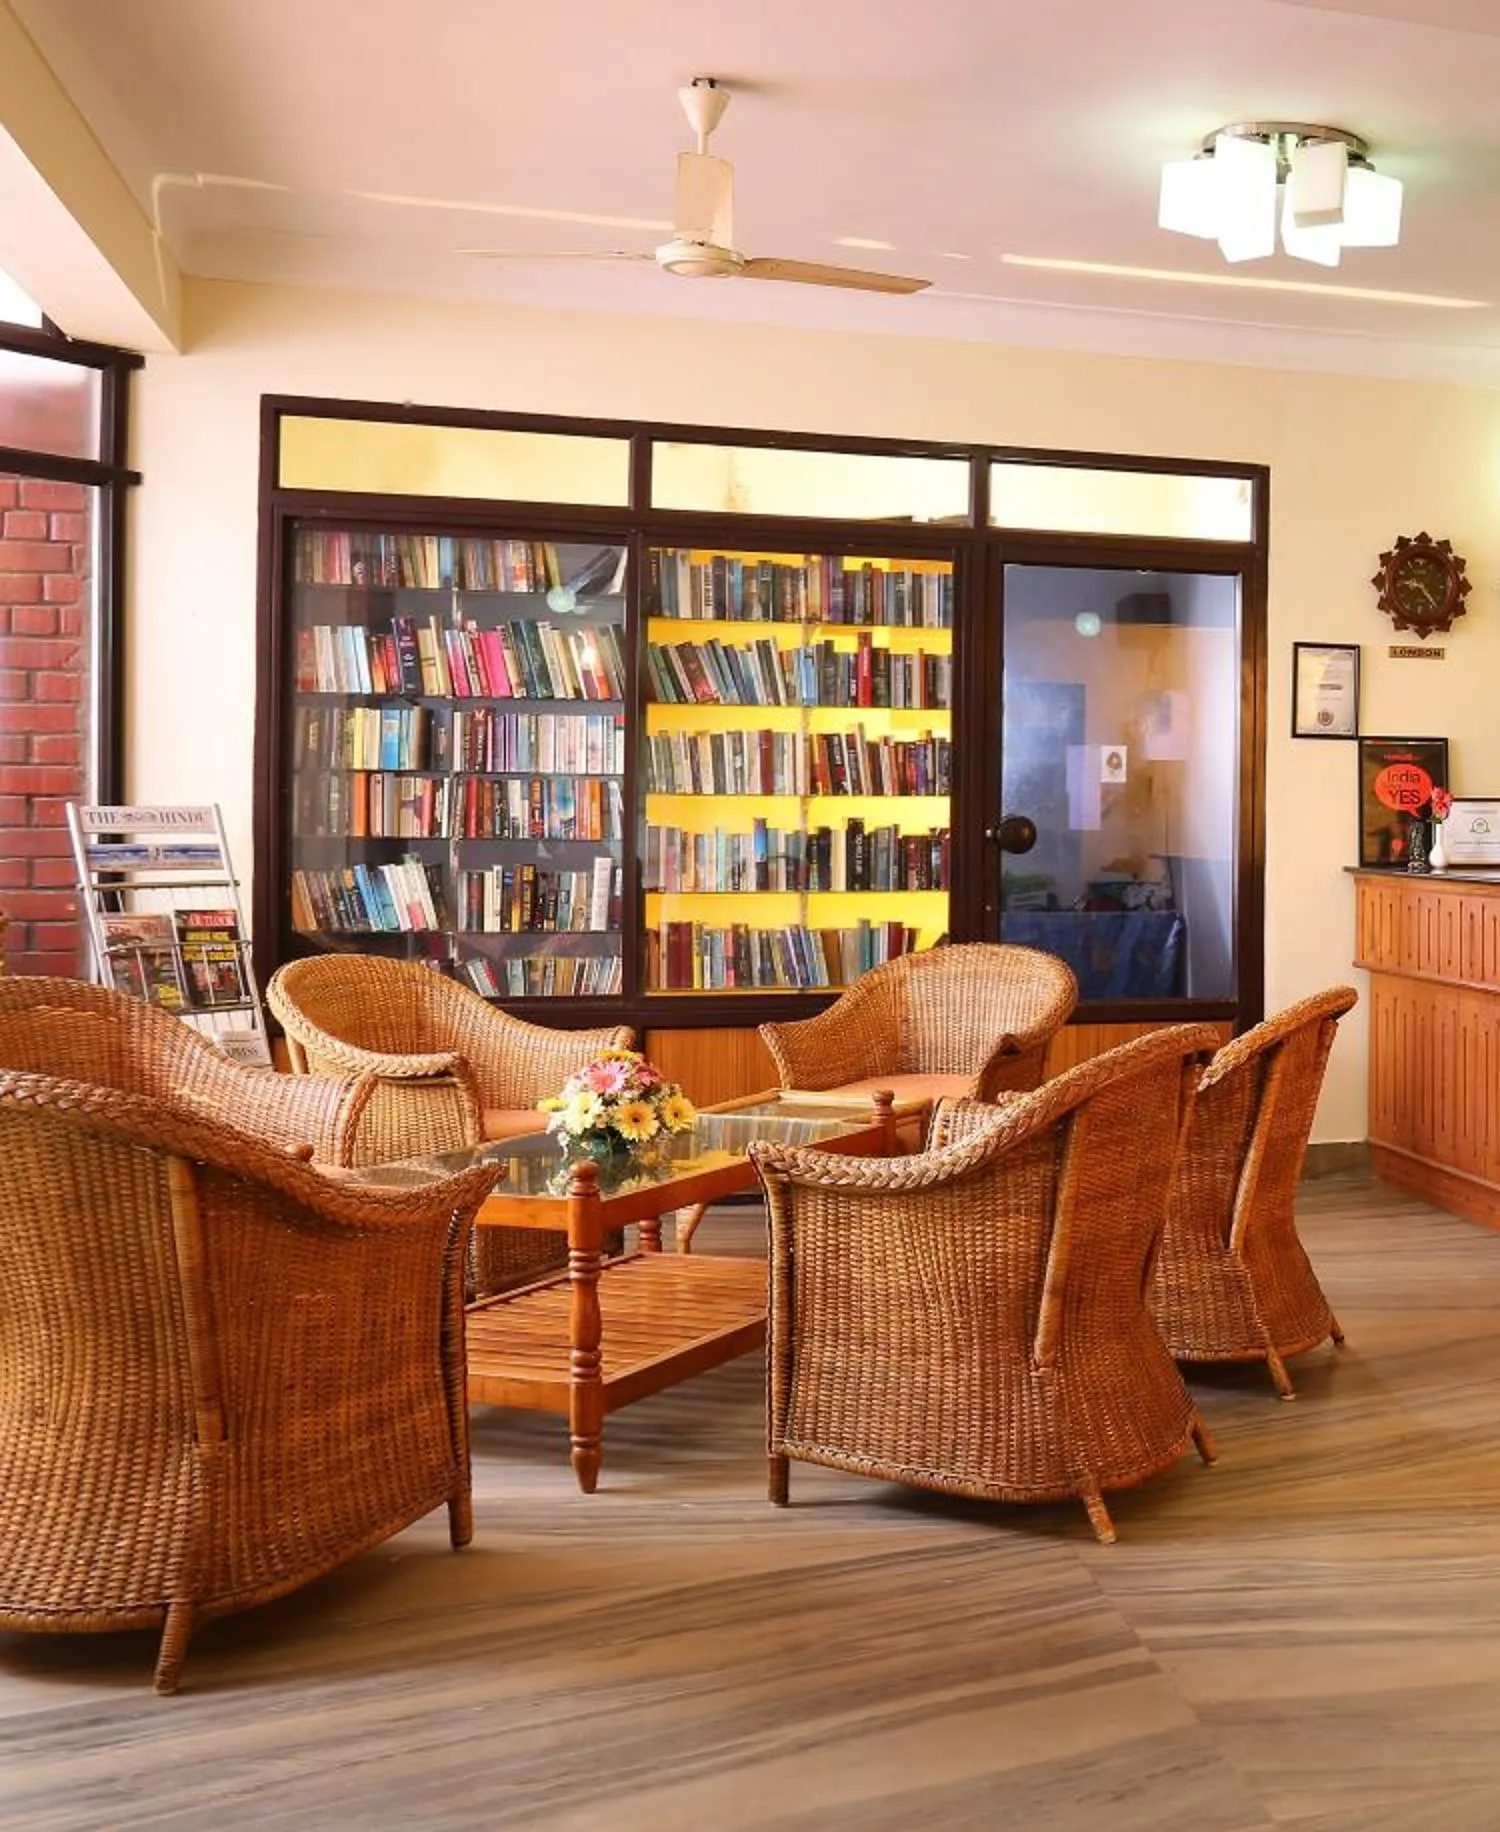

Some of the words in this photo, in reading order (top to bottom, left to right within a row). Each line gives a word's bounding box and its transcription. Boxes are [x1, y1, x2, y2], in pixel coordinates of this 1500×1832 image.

[1392, 647, 1442, 658] LONDON
[1387, 770, 1421, 784] India
[1388, 789, 1421, 804] YES
[85, 811, 118, 824] THE
